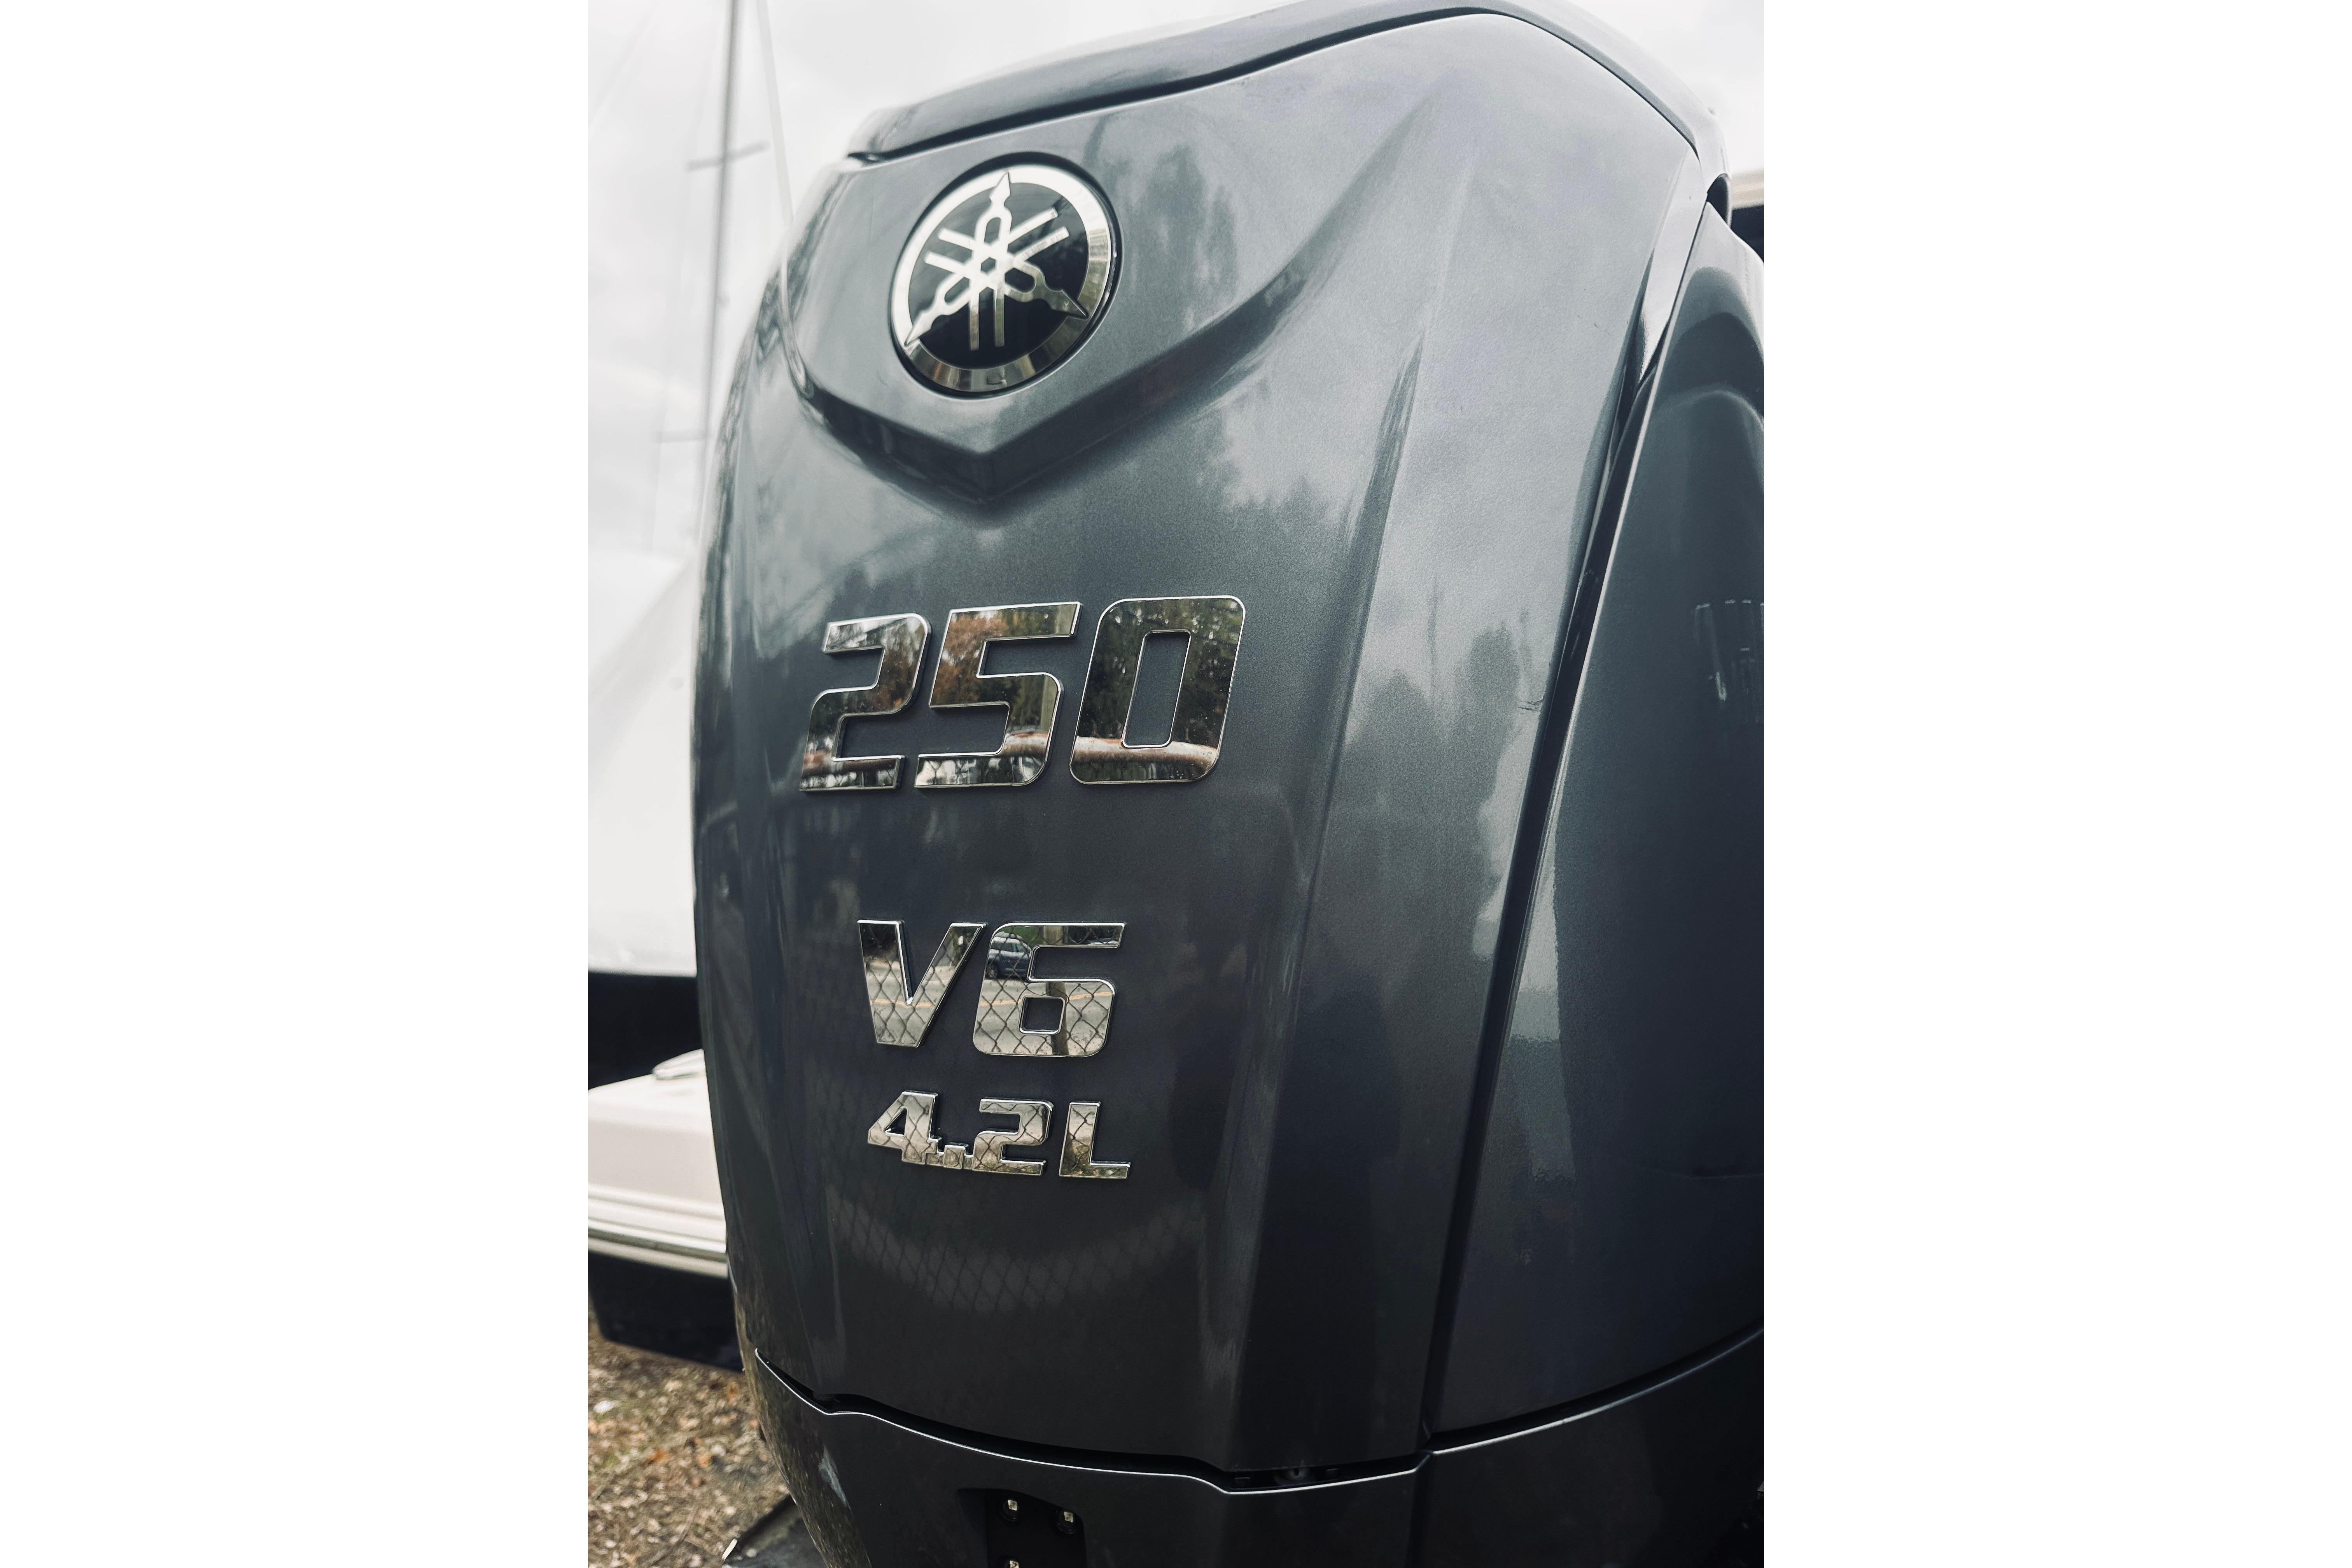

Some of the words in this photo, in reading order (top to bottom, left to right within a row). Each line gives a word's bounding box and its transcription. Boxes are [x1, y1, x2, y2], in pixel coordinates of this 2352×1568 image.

[800, 595, 1245, 791] 250
[857, 920, 1125, 1058] V6
[868, 1090, 1131, 1179] 4.2L
